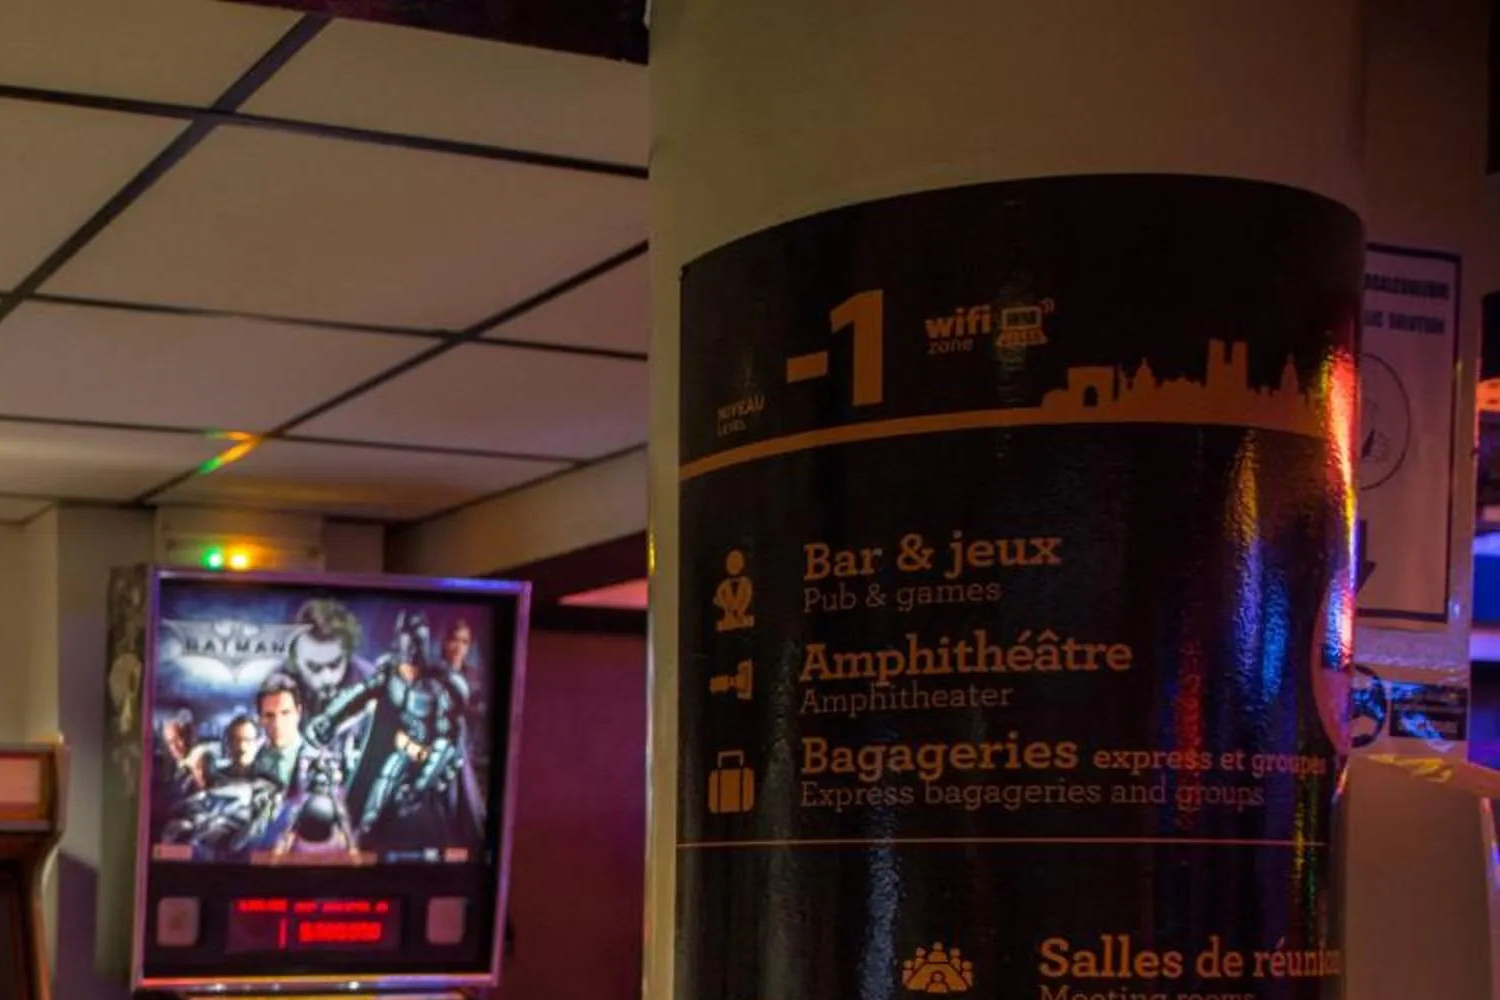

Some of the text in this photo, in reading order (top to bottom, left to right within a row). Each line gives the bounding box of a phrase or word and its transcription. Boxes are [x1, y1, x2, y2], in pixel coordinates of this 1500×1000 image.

[924, 304, 992, 340] wifi
[927, 338, 974, 356] zone
[803, 530, 1062, 581] Bar & jeux
[803, 582, 1003, 613] Pub & games
[185, 638, 286, 654] BATMAN
[799, 629, 1134, 686] Amphithéâtre
[799, 681, 1015, 718] Amphitheater
[801, 731, 1080, 781] Bagageries
[1093, 748, 1213, 776] express
[1220, 750, 1245, 771] et
[801, 775, 1265, 812] Express bagageries and groups
[1038, 934, 1184, 978] Salles
[1196, 935, 1244, 978] de
